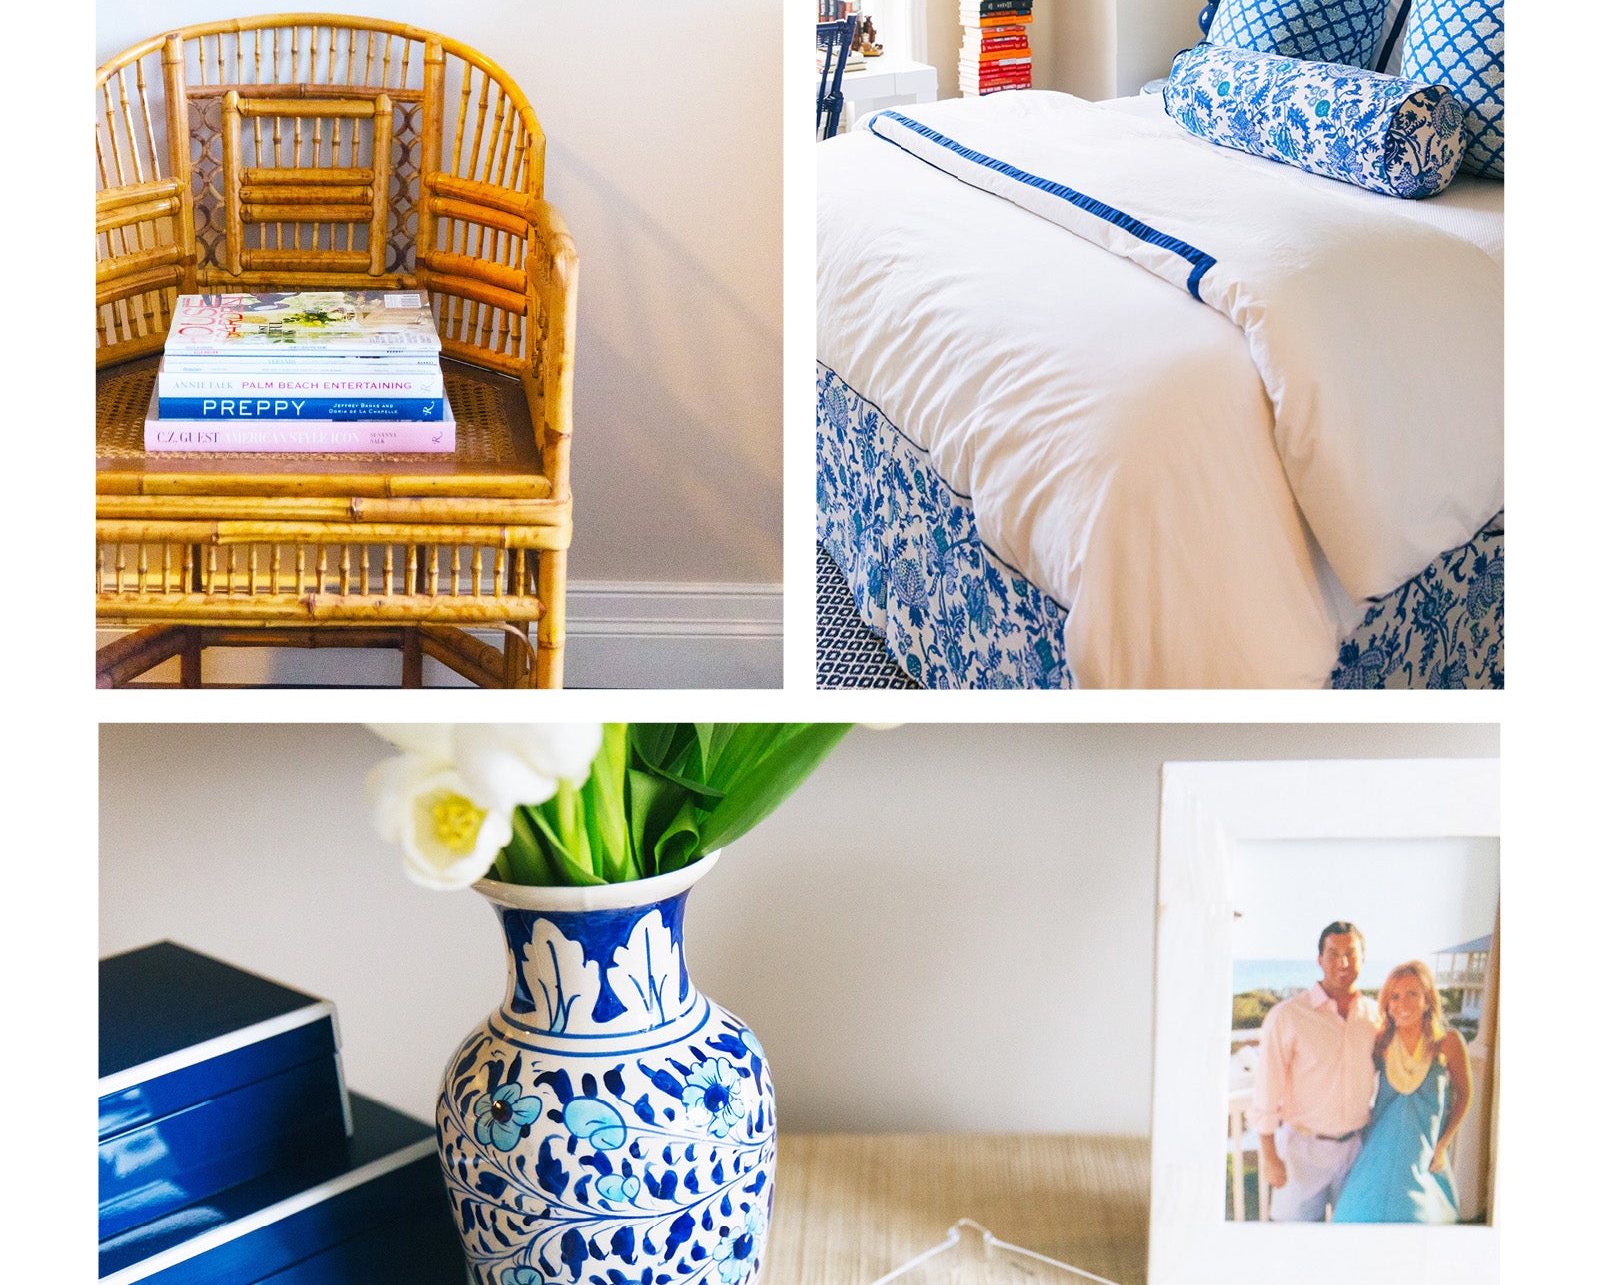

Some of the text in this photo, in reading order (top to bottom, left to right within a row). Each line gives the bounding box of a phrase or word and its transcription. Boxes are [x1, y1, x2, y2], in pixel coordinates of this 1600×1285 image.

[242, 381, 274, 389] PALM
[278, 381, 319, 390] BEACH
[323, 381, 412, 390] ENTERTAINING
[203, 400, 306, 416] PREPPY
[179, 431, 220, 443] GUEST
[225, 431, 289, 443] AMERICAN
[331, 431, 360, 444] ICON
